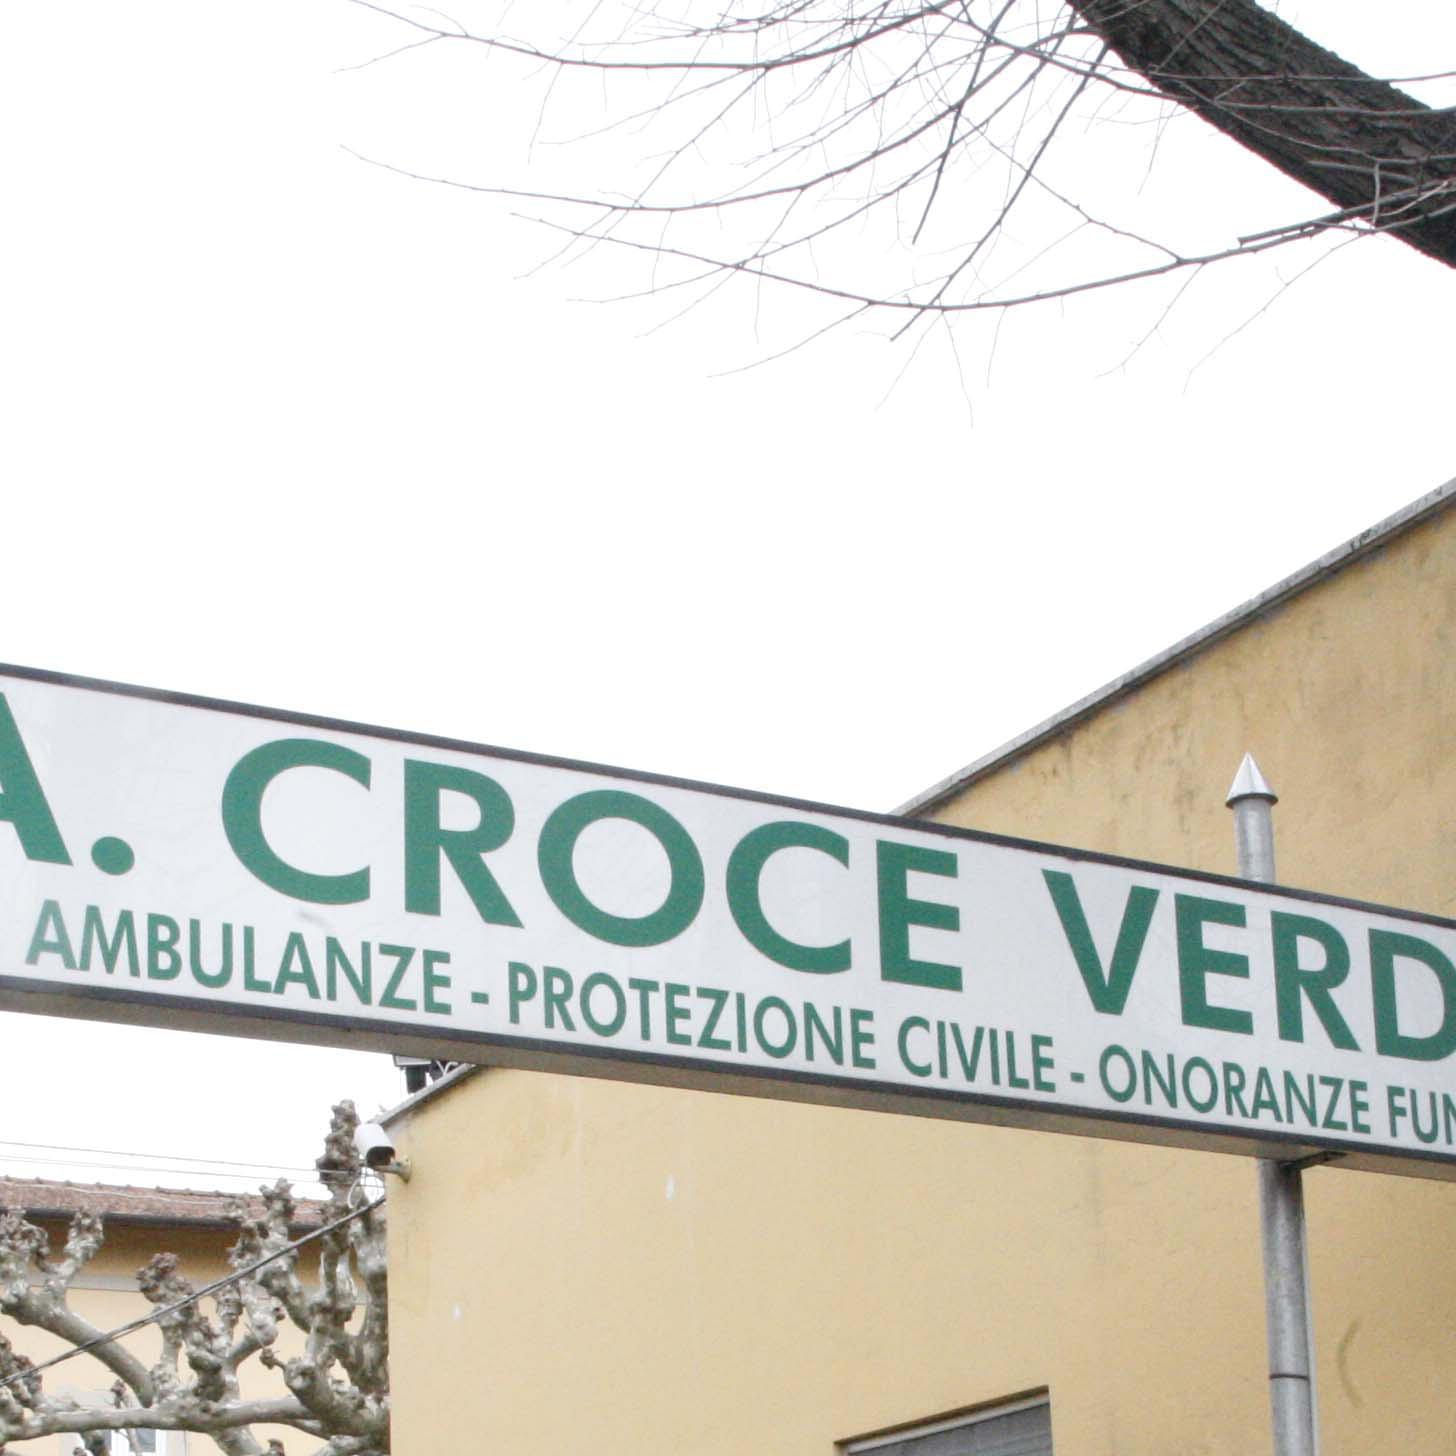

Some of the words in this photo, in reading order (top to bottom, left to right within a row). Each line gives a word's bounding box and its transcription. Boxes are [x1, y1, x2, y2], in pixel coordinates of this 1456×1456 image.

[222, 737, 963, 990] CROCE
[26, 898, 452, 1015] AMBULANZE
[508, 961, 877, 1069] PROTEZIONE
[897, 1016, 1057, 1093] CIVILE
[1098, 1043, 1371, 1134] ONORANZE
